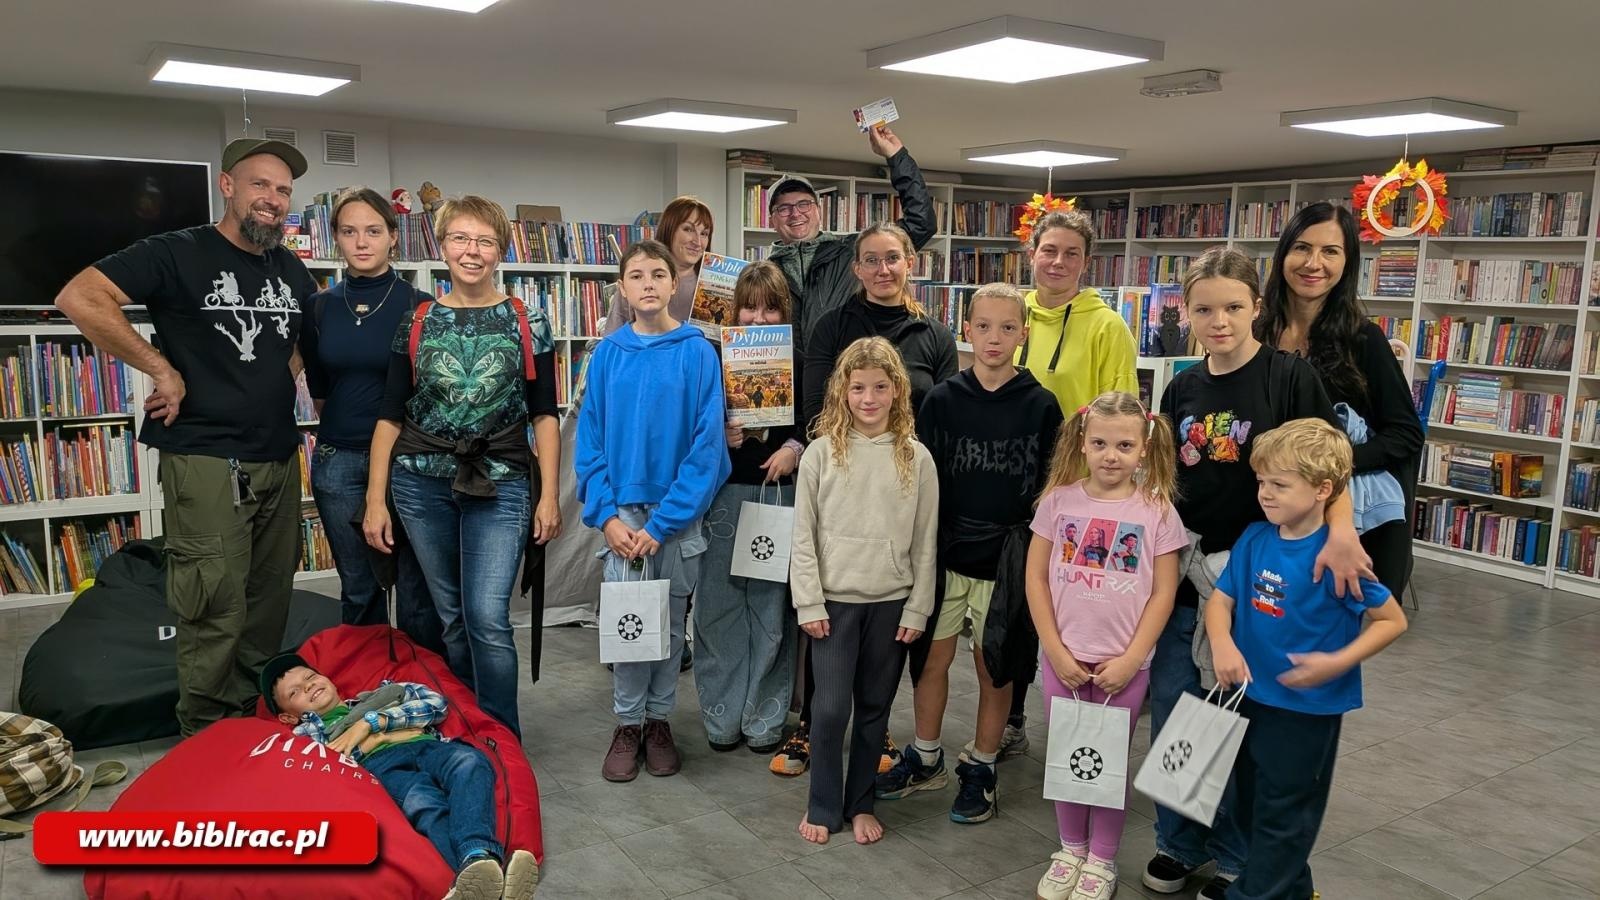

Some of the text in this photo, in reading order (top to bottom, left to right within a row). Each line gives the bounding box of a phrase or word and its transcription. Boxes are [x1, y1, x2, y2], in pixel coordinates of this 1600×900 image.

[1459, 284, 1467, 294] N
[1541, 288, 1548, 299] O
[732, 329, 784, 345] Dyplom
[732, 347, 780, 358] PINGWINY
[1262, 569, 1283, 583] Made
[1265, 583, 1275, 593] to
[1259, 595, 1275, 606] Roll
